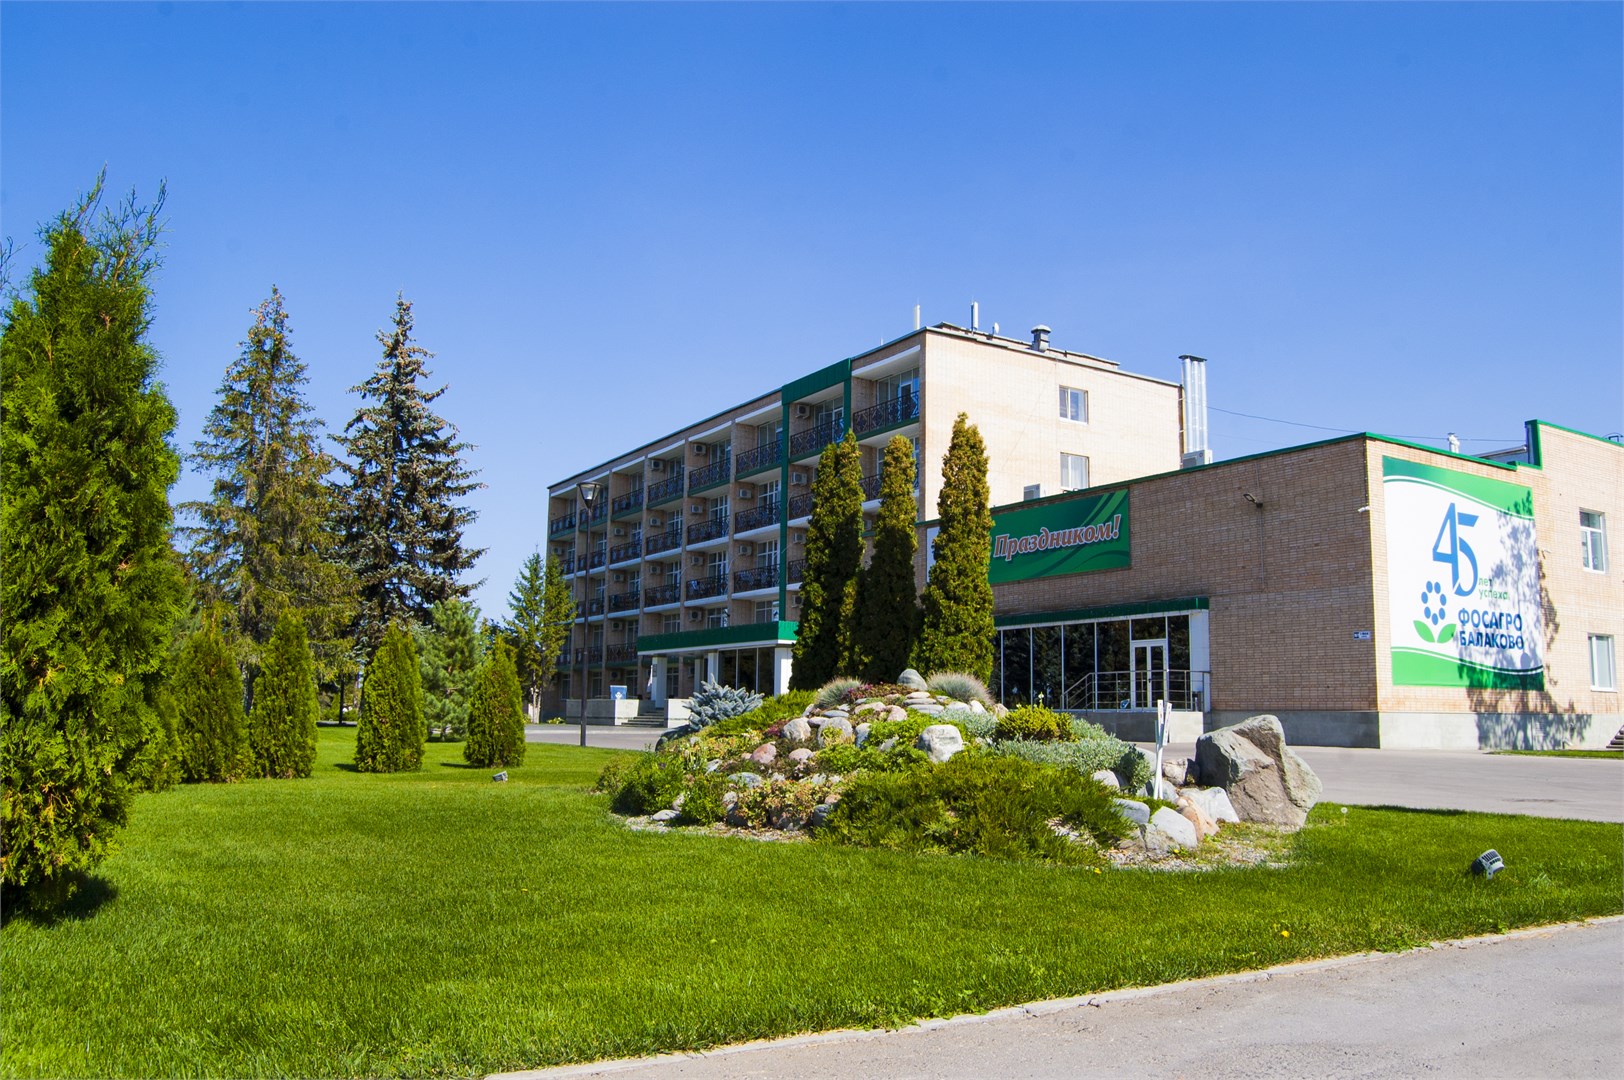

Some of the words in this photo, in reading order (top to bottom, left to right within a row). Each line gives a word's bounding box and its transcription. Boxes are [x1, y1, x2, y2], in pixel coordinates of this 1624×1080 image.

[993, 514, 1121, 561] Праздником!
[1432, 502, 1479, 597] 45
[1458, 608, 1523, 632] ФОСАГРО
[1459, 630, 1524, 651] БАЛАКОВО
